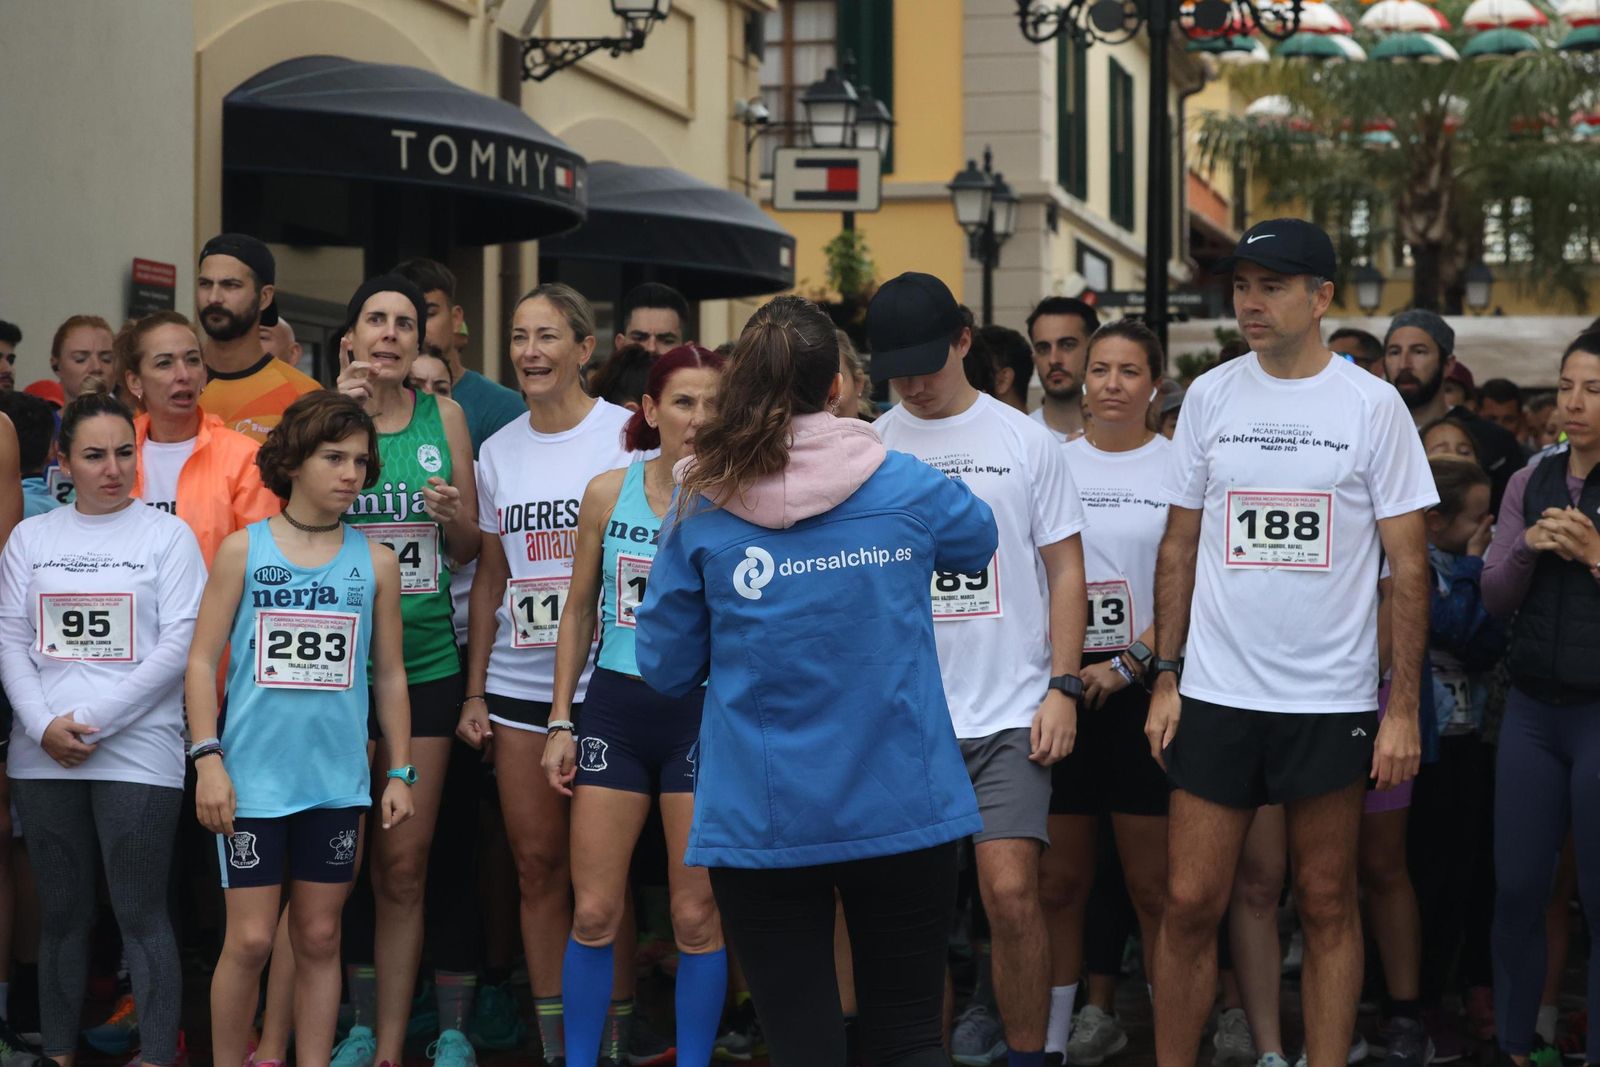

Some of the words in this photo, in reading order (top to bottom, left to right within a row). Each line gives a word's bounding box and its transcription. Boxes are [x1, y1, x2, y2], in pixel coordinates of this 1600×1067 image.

[391, 129, 548, 190] TOMMY
[1232, 434, 1298, 445] Internacional
[1299, 437, 1312, 445] de
[1312, 438, 1322, 446] la
[1323, 440, 1350, 452] Mujer
[497, 499, 580, 536] LIDERES
[1237, 510, 1320, 541] 188
[255, 566, 291, 582] TROPS
[779, 546, 912, 577] dorsalchip.es
[252, 581, 339, 611] nerja
[62, 610, 110, 637] 95
[267, 630, 347, 662] 283
